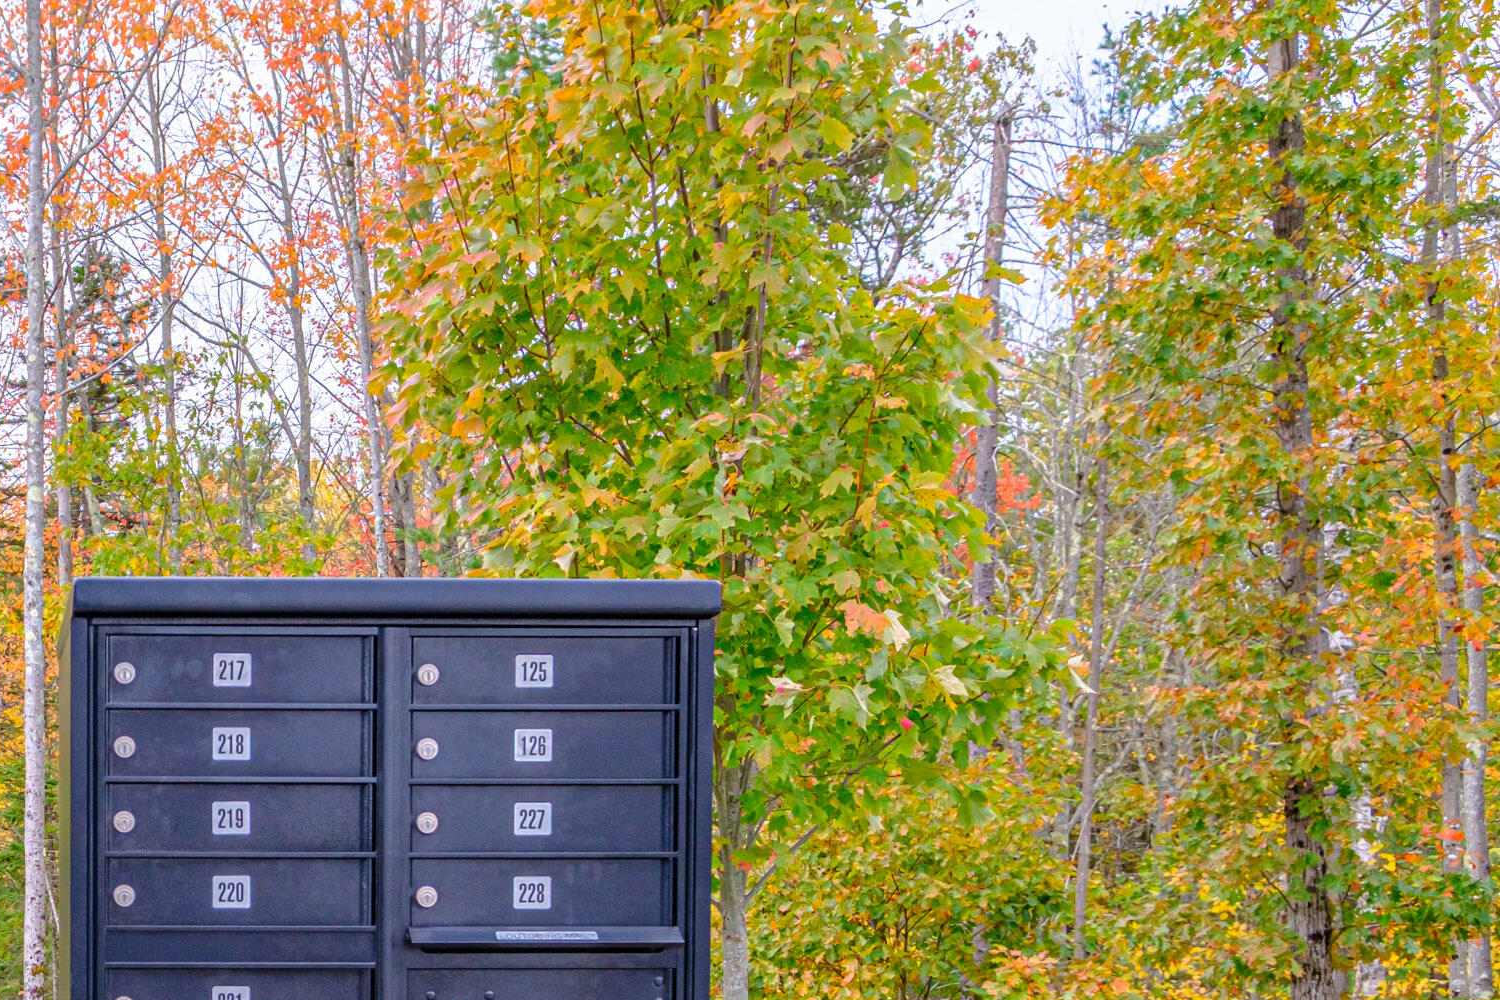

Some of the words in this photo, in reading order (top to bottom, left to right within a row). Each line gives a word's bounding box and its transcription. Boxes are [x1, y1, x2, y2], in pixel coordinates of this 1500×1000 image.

[219, 660, 245, 681] 217
[521, 661, 547, 682] 125
[218, 734, 244, 755] 218
[520, 735, 546, 756] 126
[218, 808, 244, 829] 219
[519, 809, 545, 830] 227
[218, 882, 244, 903] 220
[519, 883, 545, 904] 228
